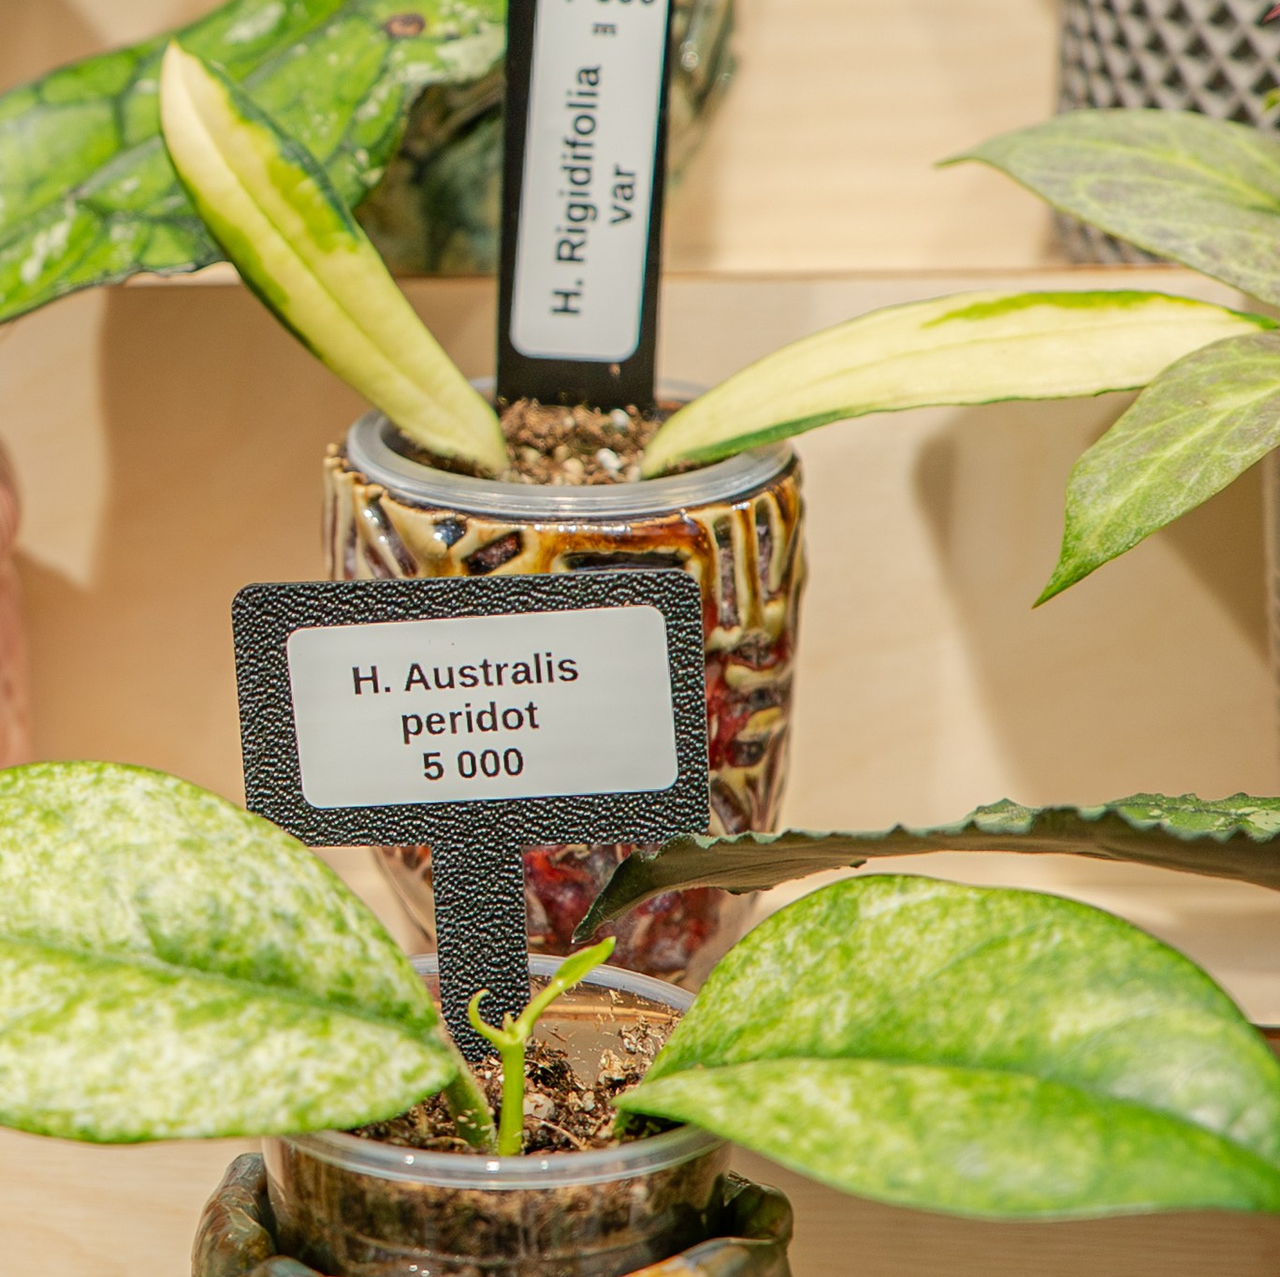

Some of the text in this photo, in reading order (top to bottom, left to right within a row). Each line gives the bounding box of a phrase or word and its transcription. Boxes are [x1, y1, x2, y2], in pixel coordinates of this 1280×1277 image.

[549, 65, 601, 316] H. Rigidifolia
[608, 164, 637, 226] var
[351, 651, 579, 696] H. Australis
[401, 701, 540, 745] peridot
[422, 747, 524, 781] 5 000
